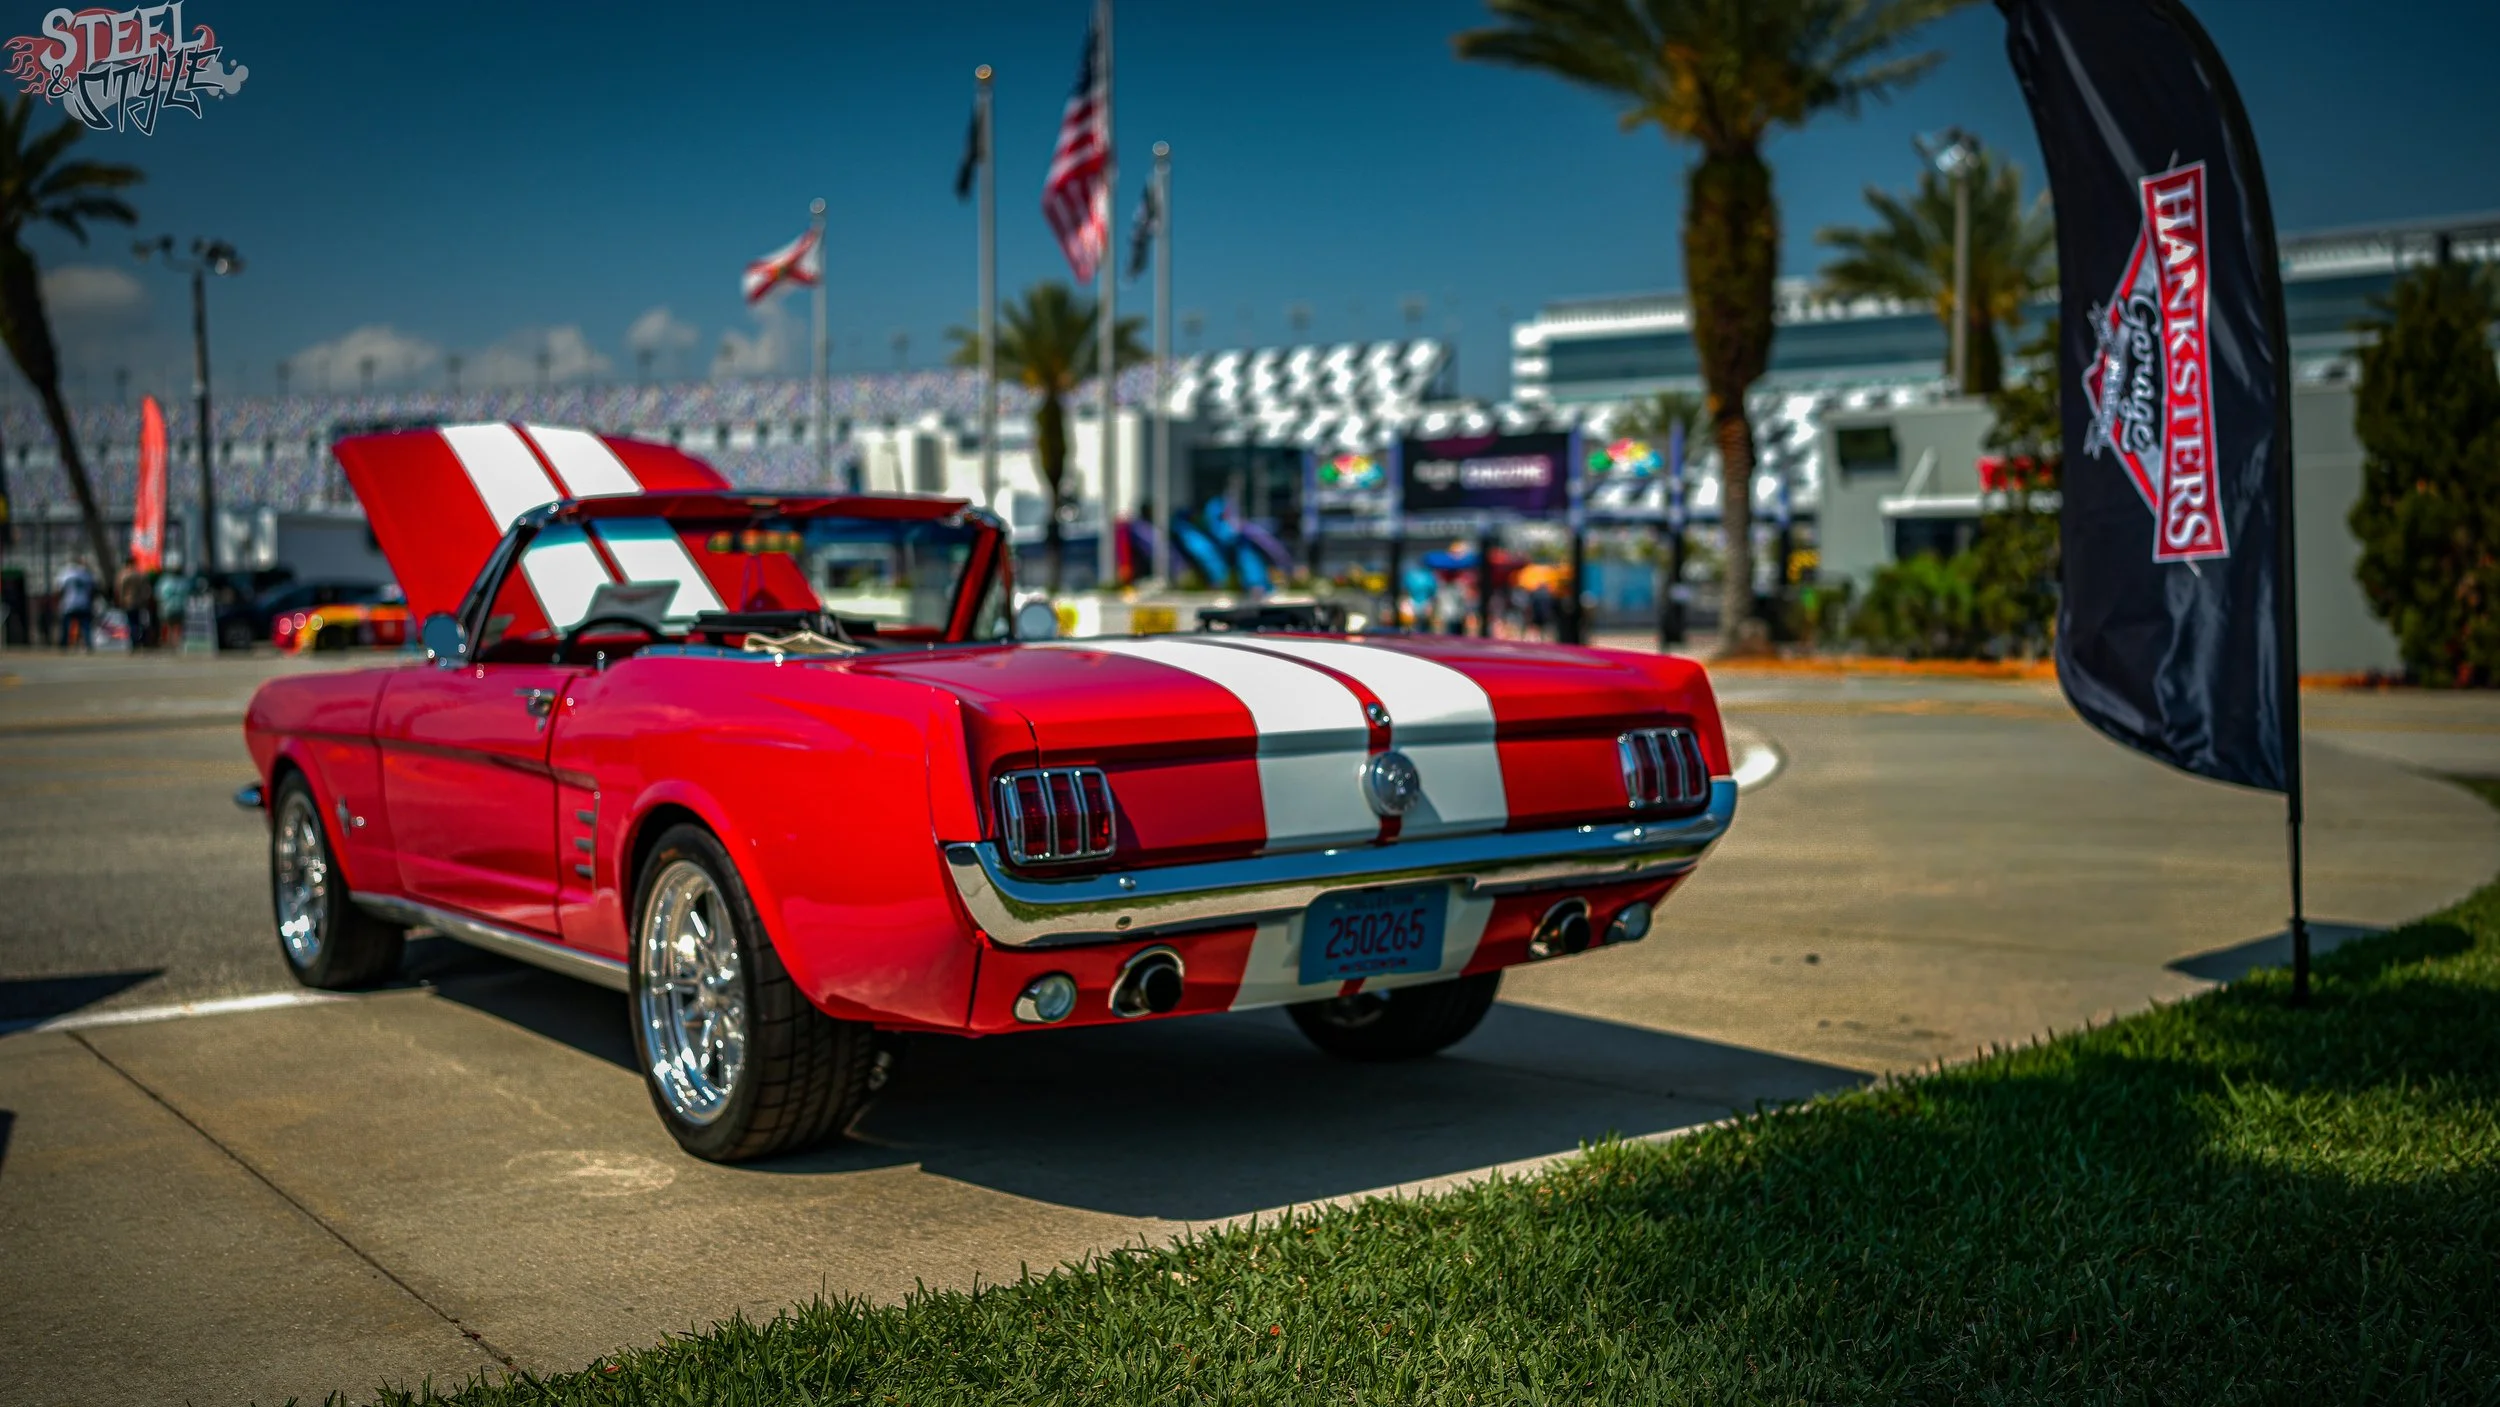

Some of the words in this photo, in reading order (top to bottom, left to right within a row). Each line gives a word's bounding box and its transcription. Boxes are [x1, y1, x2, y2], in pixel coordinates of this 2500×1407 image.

[2117, 295, 2162, 453] Garage
[2153, 176, 2213, 550] HANKSTERS
[1325, 908, 1426, 960] 250265
